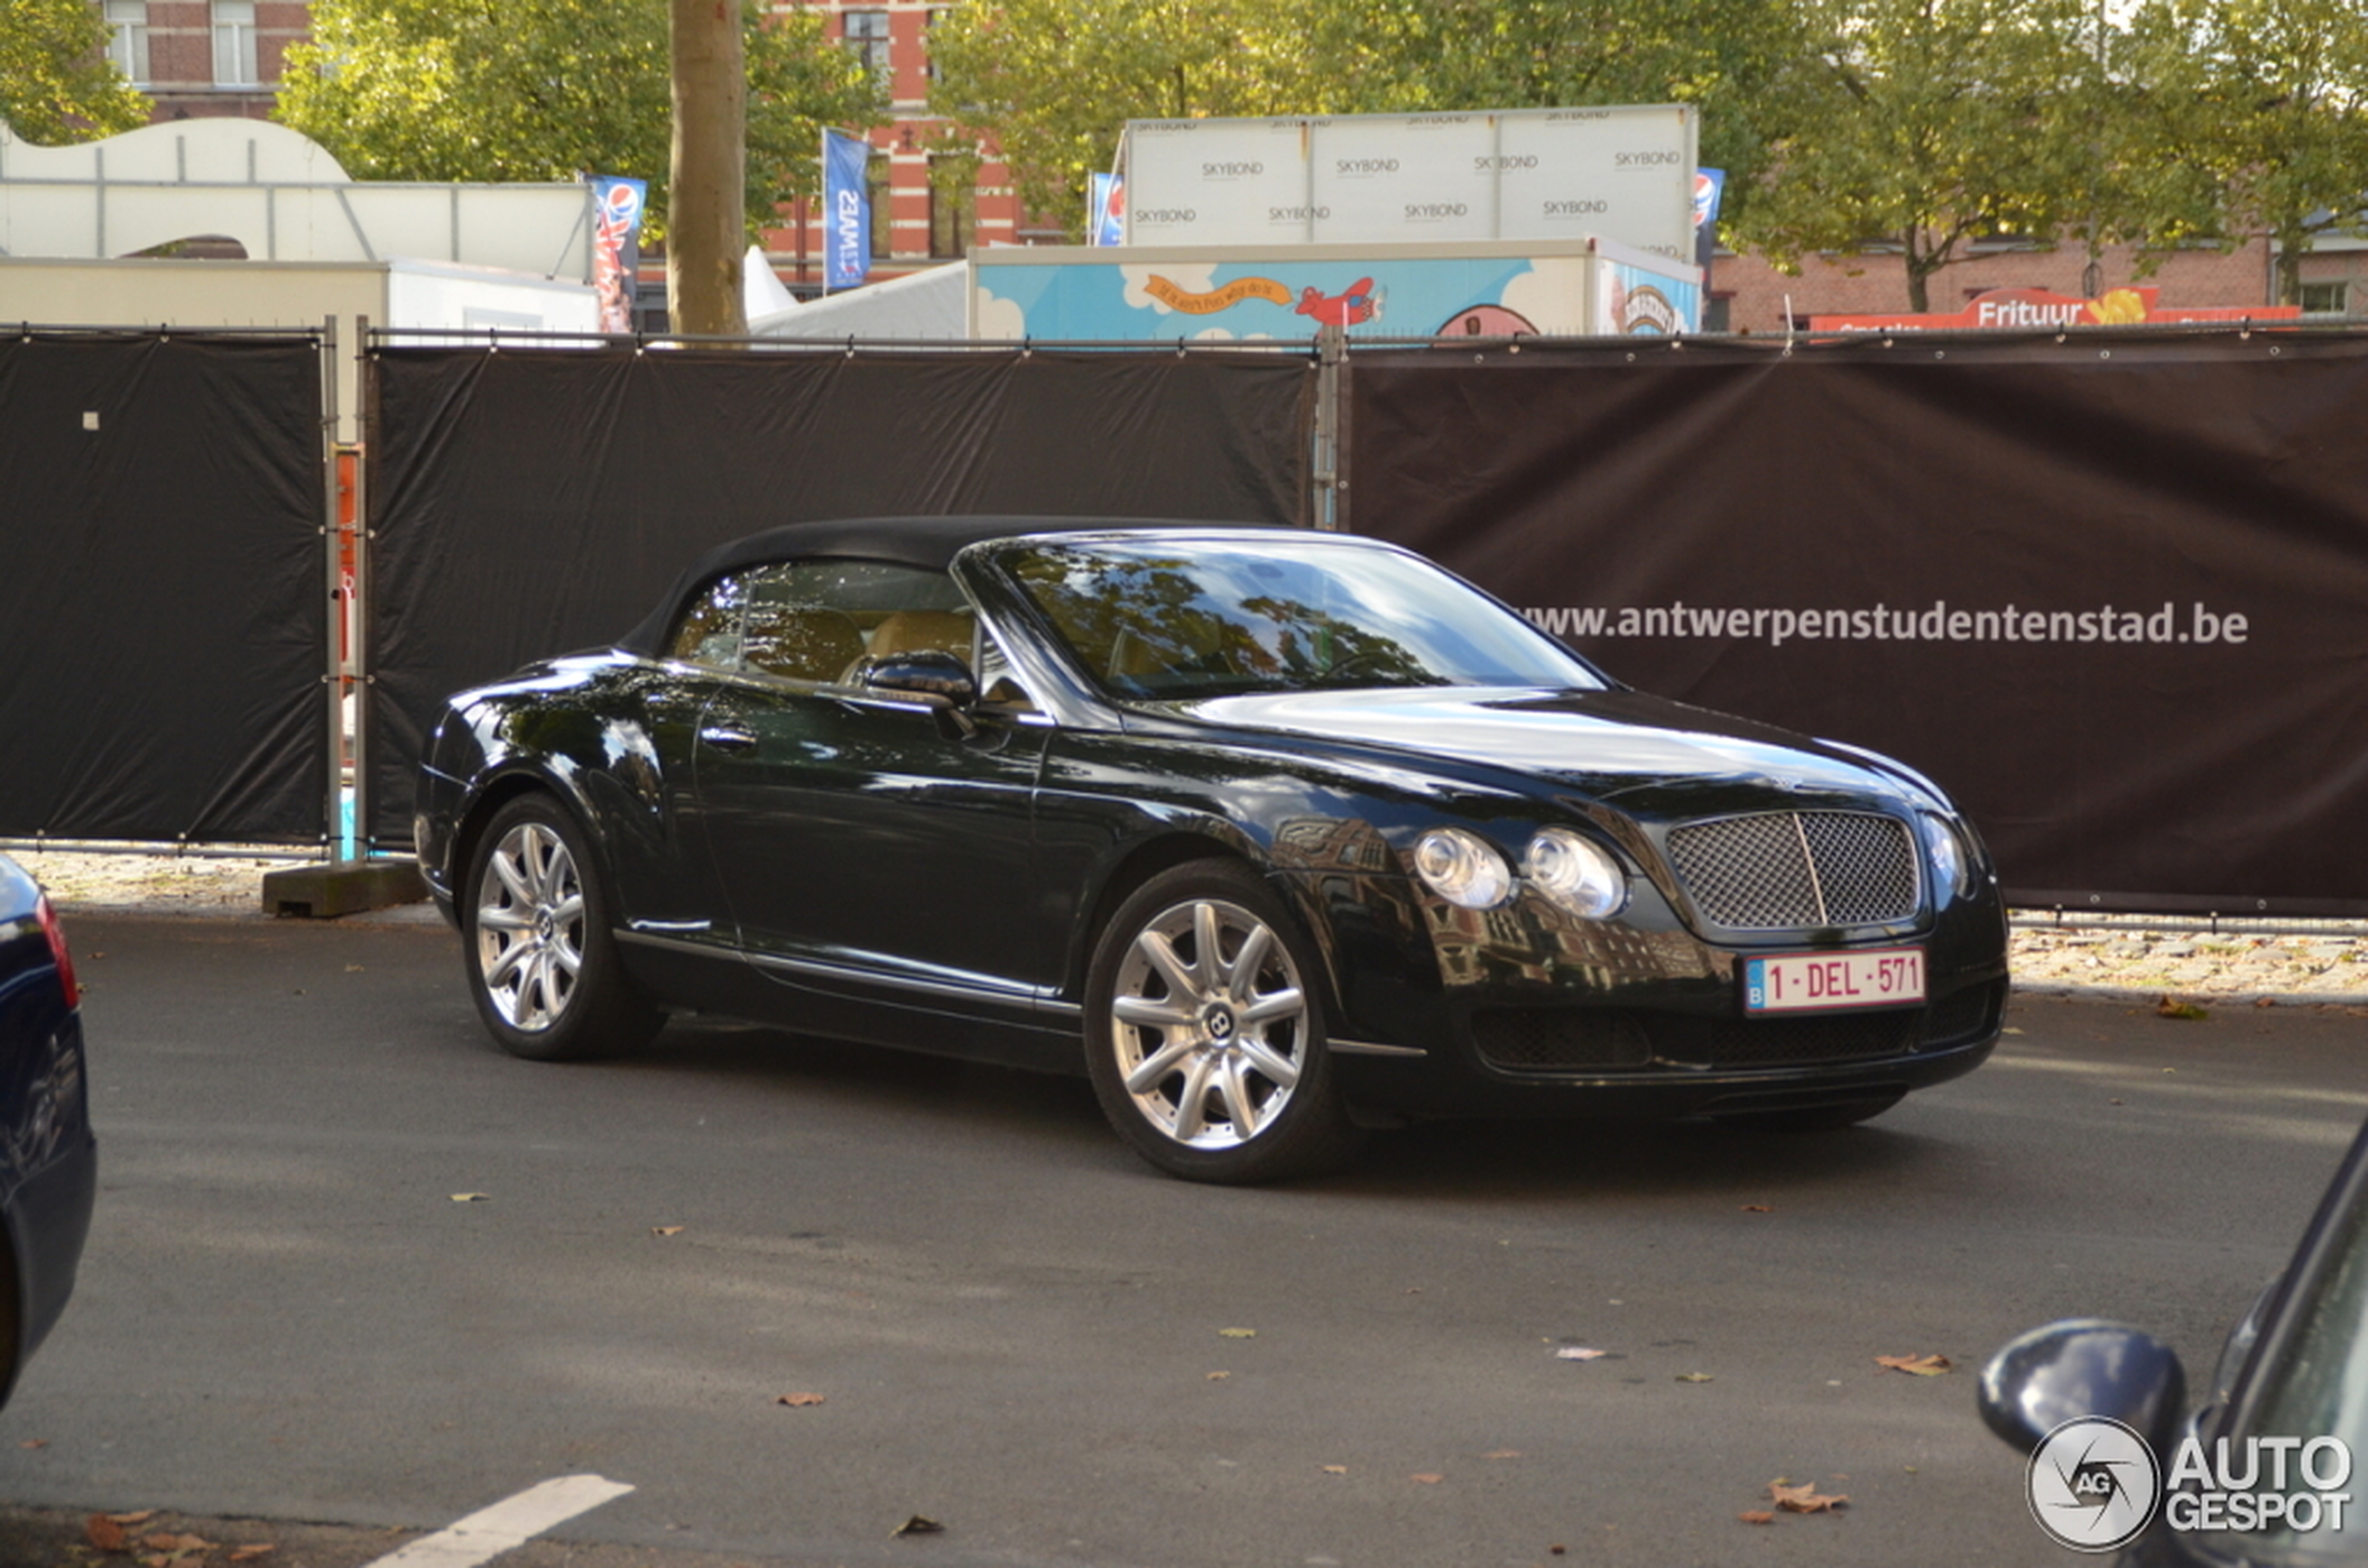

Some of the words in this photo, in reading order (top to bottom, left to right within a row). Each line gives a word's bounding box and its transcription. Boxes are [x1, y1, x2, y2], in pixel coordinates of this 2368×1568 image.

[1337, 159, 1399, 173] SKYBOND
[1474, 155, 1539, 170] SKBOND
[1615, 151, 1680, 166] SKYBOND
[1203, 162, 1263, 176] SKYBOND
[1405, 203, 1467, 218] SKYBOND
[1544, 199, 1608, 214] SKYBOND
[1136, 209, 1196, 223] SKYBOND
[1248, 282, 1261, 295] do
[1979, 300, 2084, 326] Frituur
[1748, 987, 1763, 1005] B
